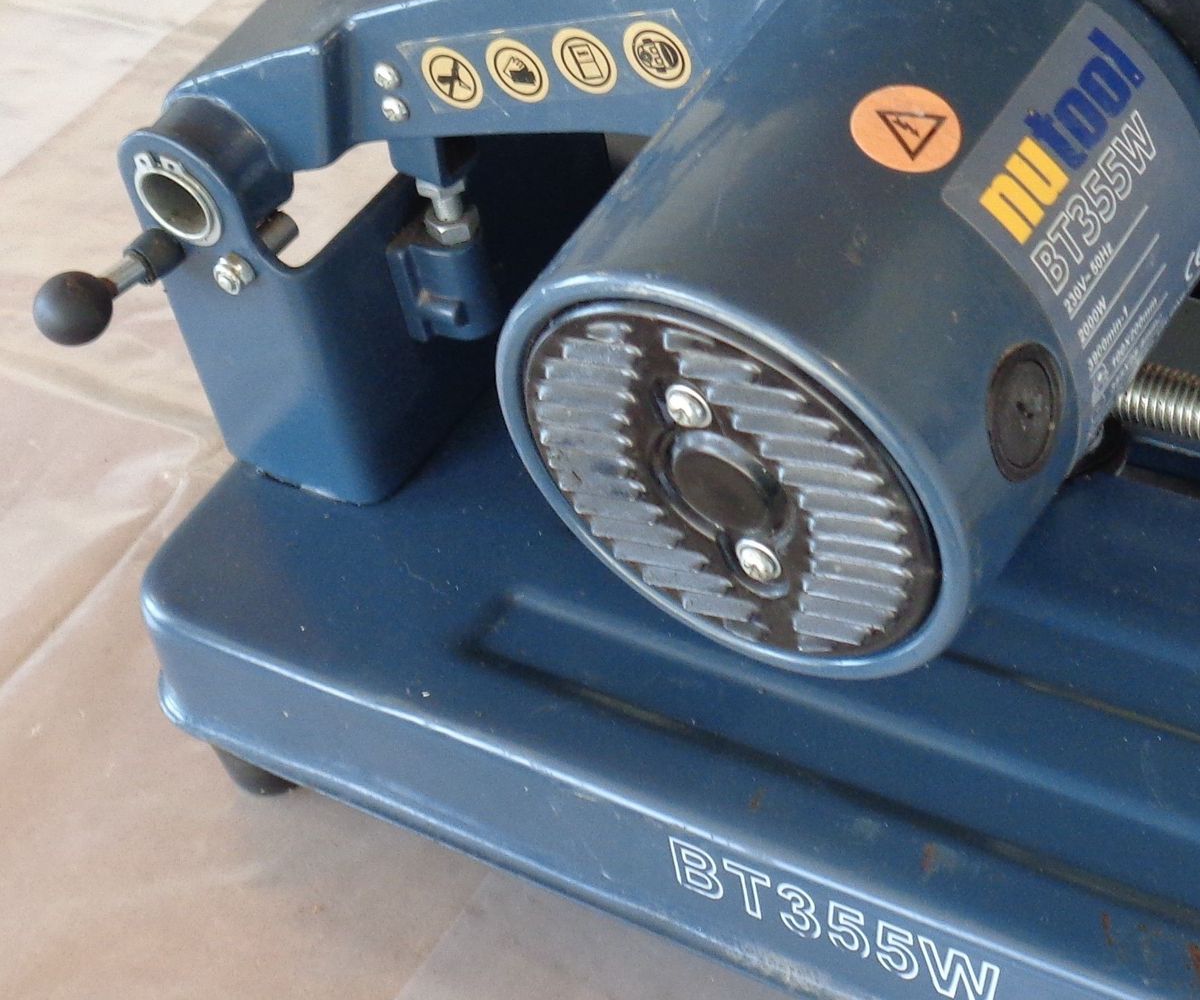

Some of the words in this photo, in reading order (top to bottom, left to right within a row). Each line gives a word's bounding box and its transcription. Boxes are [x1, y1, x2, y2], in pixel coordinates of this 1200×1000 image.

[979, 26, 1146, 246] nutool
[1030, 109, 1158, 296] BT355W
[1078, 294, 1107, 344] 2000W
[668, 836, 1000, 1000] BT355W
